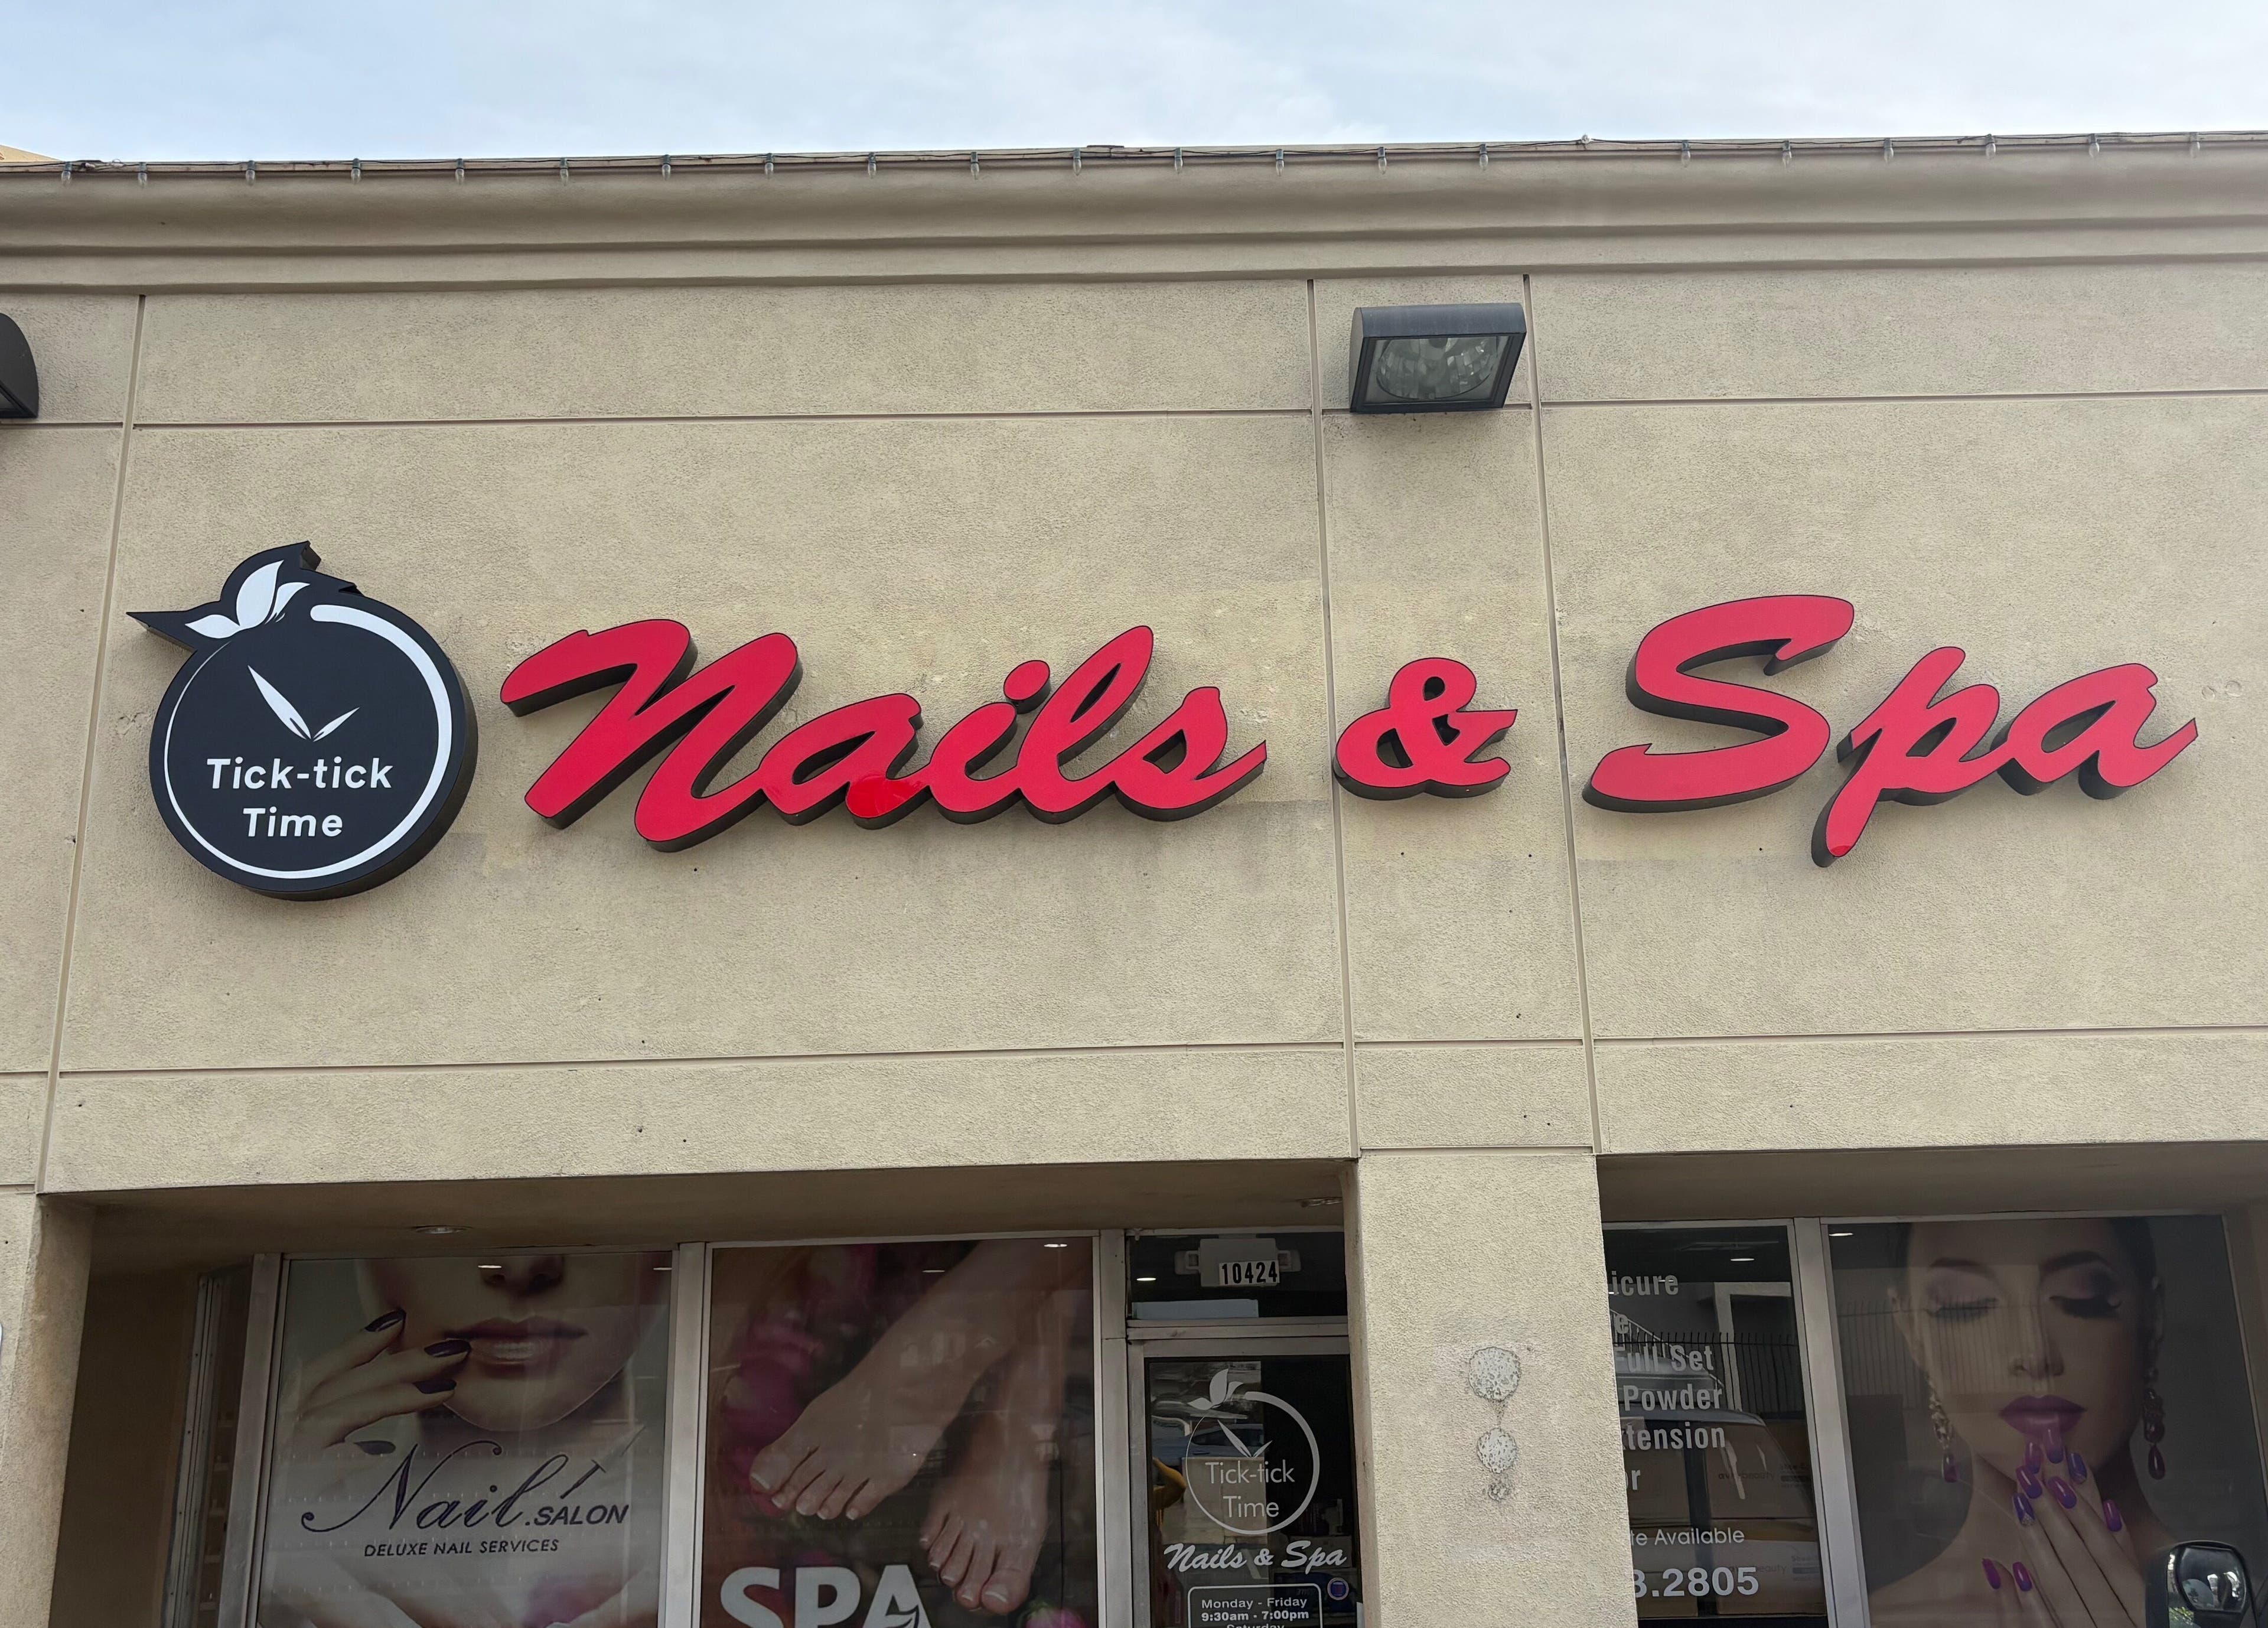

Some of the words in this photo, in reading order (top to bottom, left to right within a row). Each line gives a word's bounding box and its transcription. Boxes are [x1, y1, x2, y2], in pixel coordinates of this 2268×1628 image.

[500, 618, 1267, 848] Nails
[1334, 657, 1518, 794] &
[1585, 594, 2198, 862] Spa
[206, 756, 393, 789] Tick-tick
[243, 806, 344, 838] Time
[1221, 1261, 1278, 1285] 10424
[1670, 1344, 1713, 1372] Set
[1623, 1383, 1722, 1411] Powder
[1622, 1421, 1725, 1450] tension
[1205, 1459, 1295, 1484] Tick-tick
[1223, 1495, 1279, 1518] Time
[364, 1542, 426, 1558] DELUXE
[435, 1541, 473, 1555] NAIL
[480, 1539, 560, 1554] SERVICES
[1654, 1526, 1745, 1545] Available
[1164, 1543, 1247, 1572] Nails
[1253, 1548, 1275, 1566] &
[1280, 1540, 1347, 1575] Spa
[720, 1564, 934, 1627] SPA
[1201, 1599, 1253, 1610] Monday
[1267, 1597, 1308, 1609] Friday
[1201, 1611, 1249, 1622] 9:30am
[1262, 1610, 1309, 1621] 7:00pm
